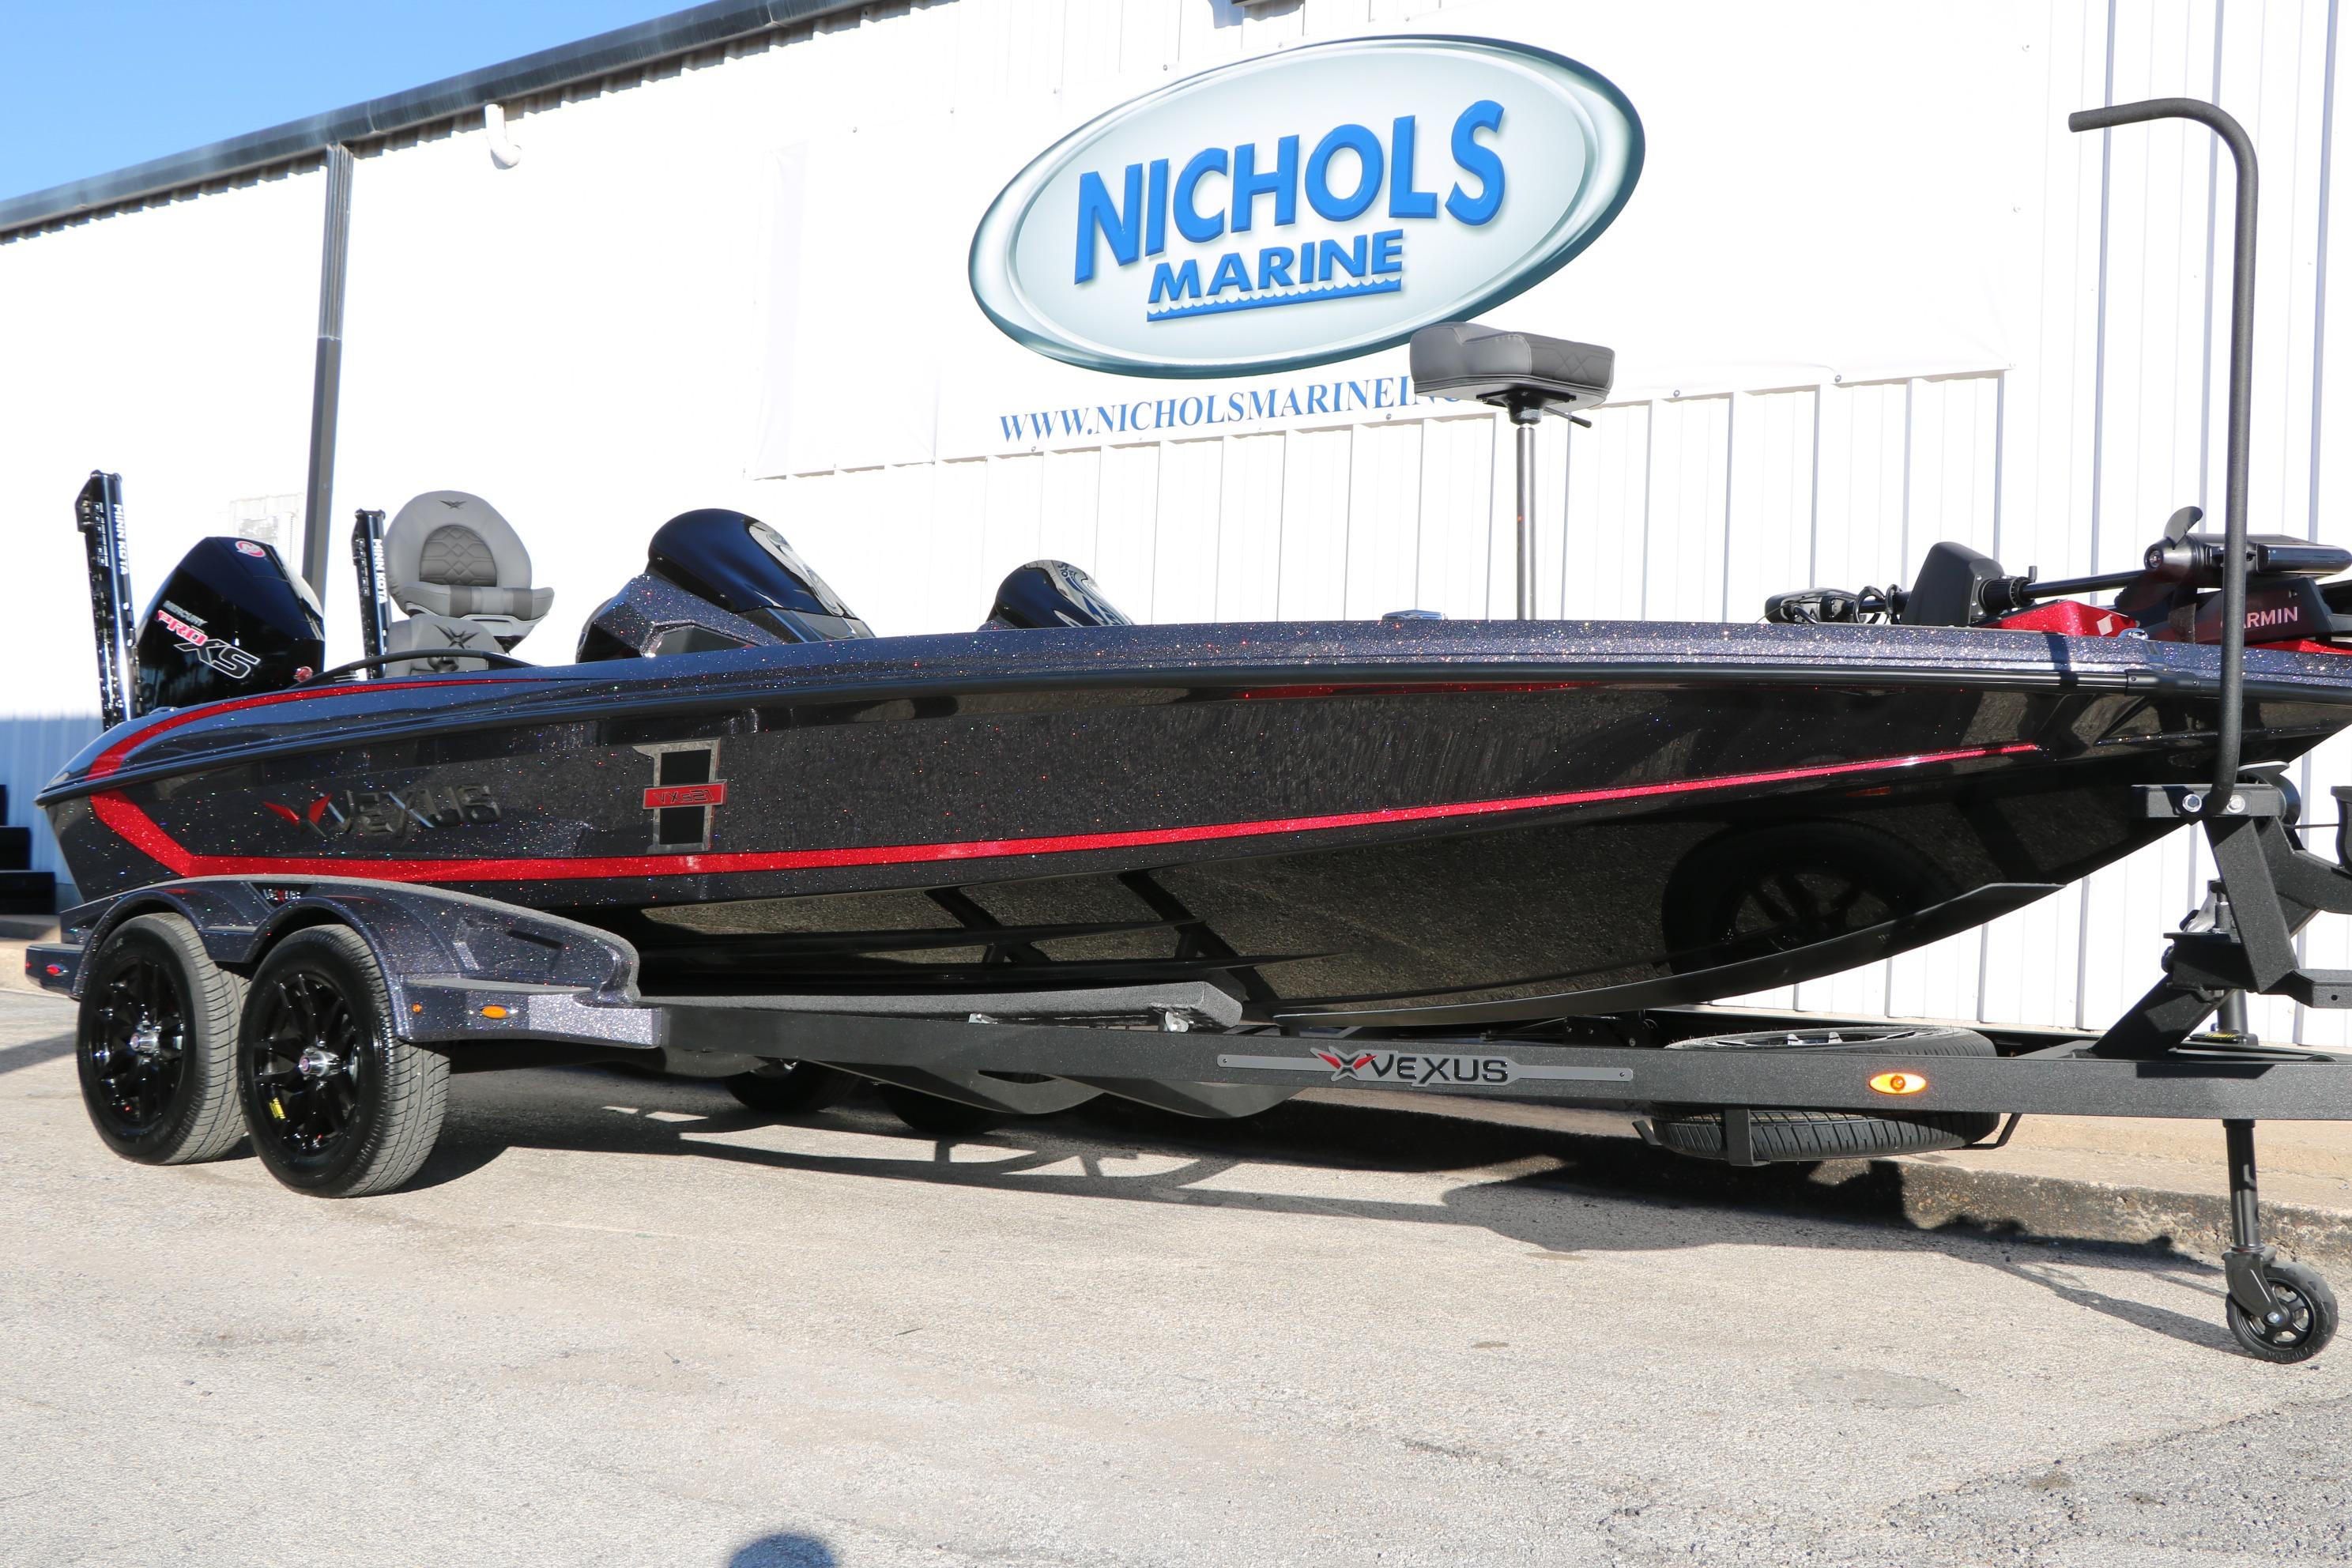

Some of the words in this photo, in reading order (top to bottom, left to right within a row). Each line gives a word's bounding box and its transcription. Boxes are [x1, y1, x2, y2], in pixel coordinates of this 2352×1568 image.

[1074, 100, 1506, 285] NICHOLS
[1148, 229, 1404, 305] MARINE
[998, 375, 1461, 443] WWW.NICHOLSMARINEI
[113, 503, 126, 539] MINN
[118, 540, 129, 575] KOTA
[372, 538, 385, 571] MINN
[376, 572, 388, 605] KOTA
[155, 609, 209, 646] PRO
[2220, 605, 2298, 629] RMIN
[173, 638, 262, 680] XS
[318, 785, 503, 842] VEXUS
[1365, 1052, 1509, 1084] VEXUS
